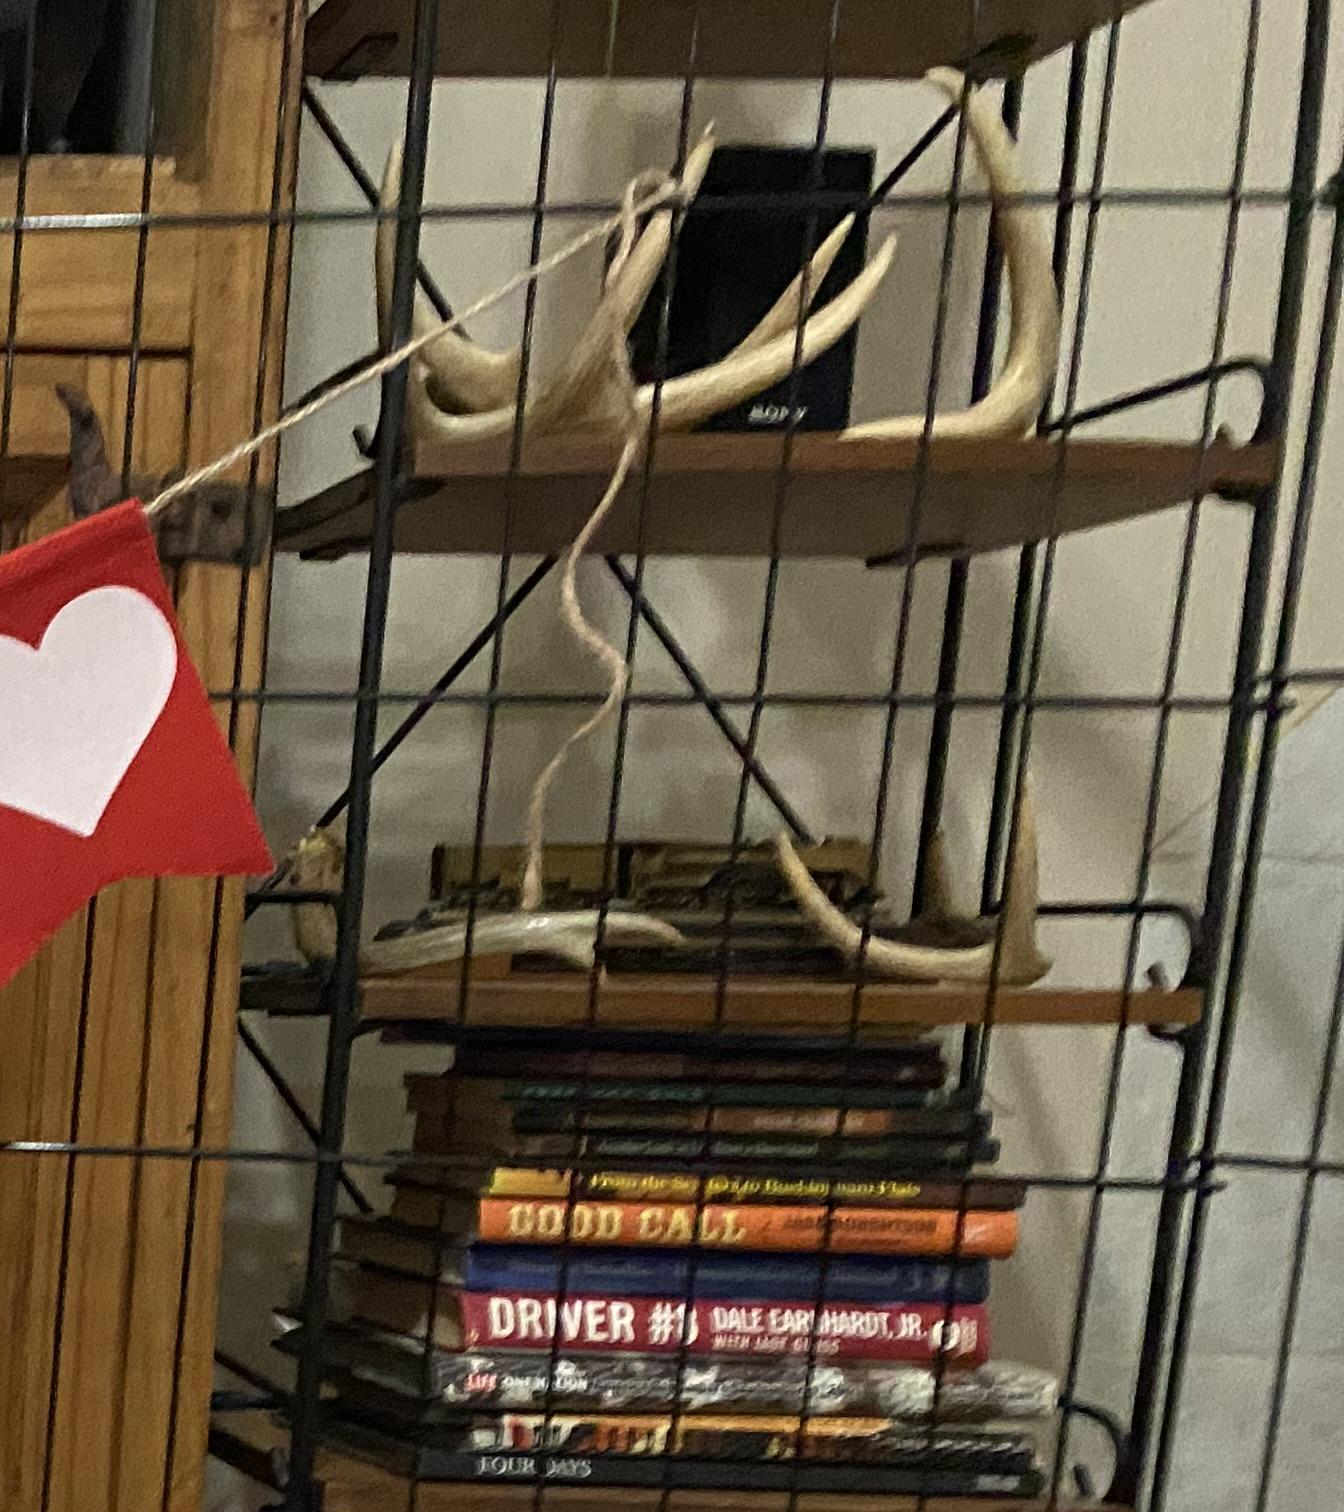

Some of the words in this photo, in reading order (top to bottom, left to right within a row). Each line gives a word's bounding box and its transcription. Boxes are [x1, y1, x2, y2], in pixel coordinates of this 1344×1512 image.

[509, 1203, 623, 1240] GOOD
[639, 1206, 747, 1243] CALL
[488, 1296, 636, 1343] DRIVER
[711, 1306, 765, 1334] DALE
[896, 1313, 928, 1339] JR.
[477, 1455, 536, 1476] FOUR
